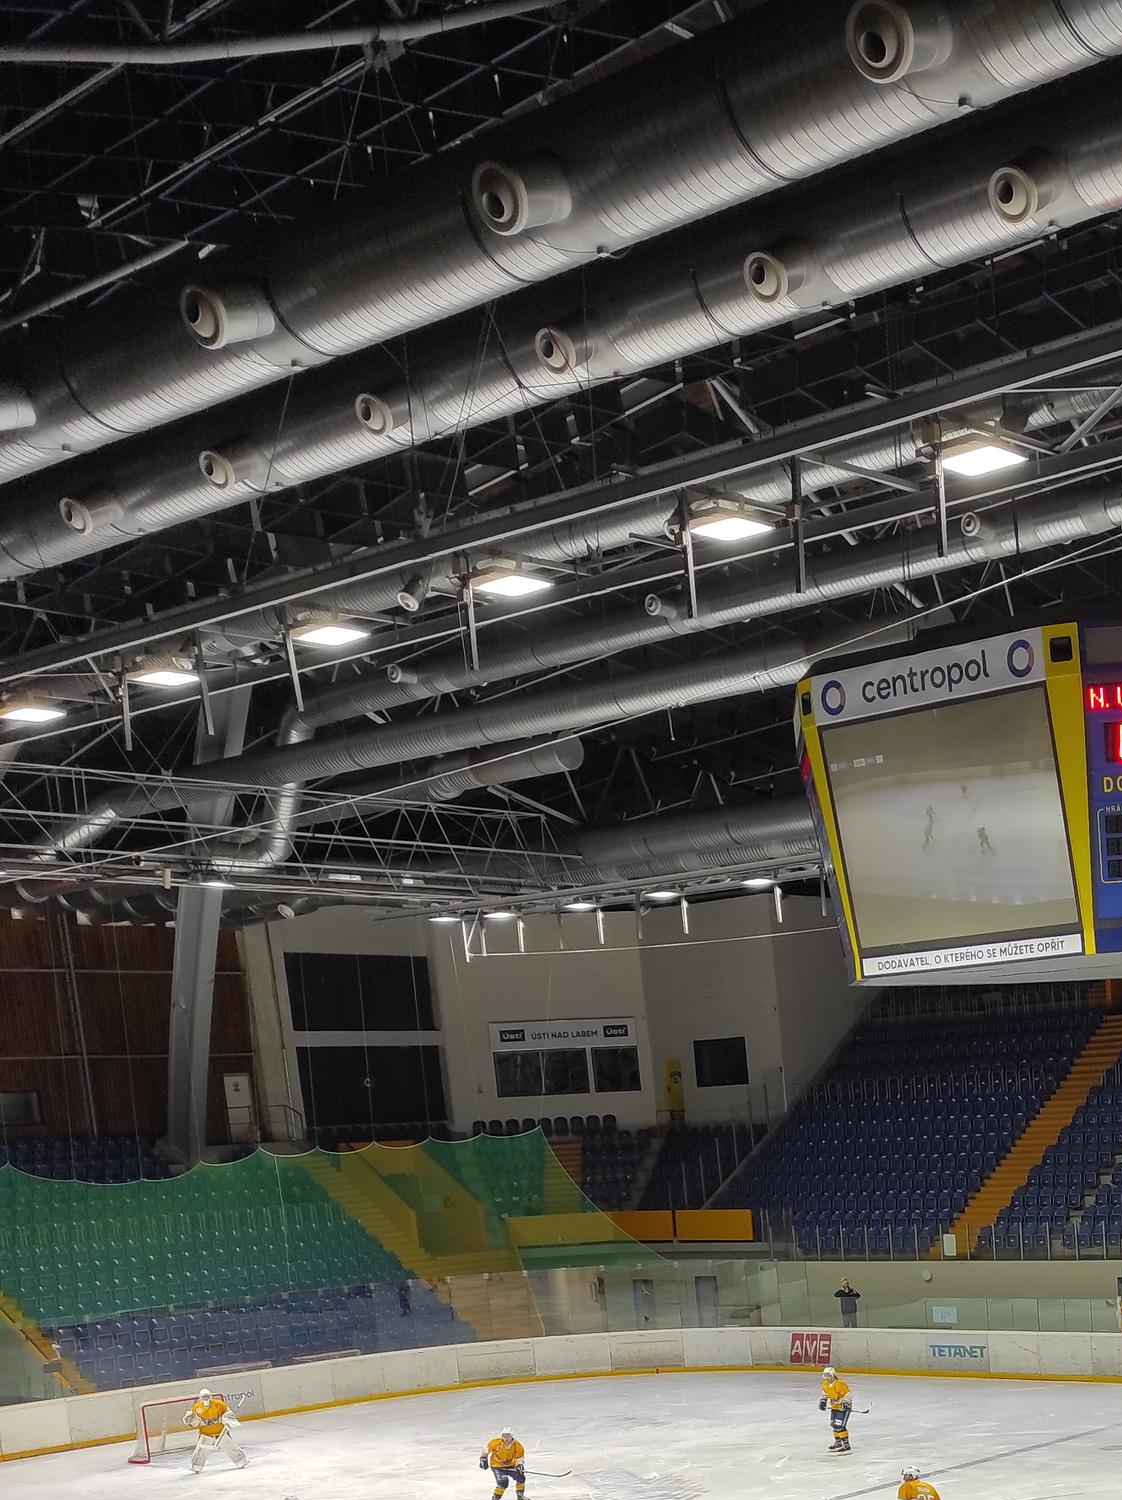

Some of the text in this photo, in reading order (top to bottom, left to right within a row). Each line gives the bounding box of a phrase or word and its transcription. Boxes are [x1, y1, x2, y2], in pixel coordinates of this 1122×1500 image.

[862, 650, 989, 703] centropol
[877, 956, 931, 971] DODAVATEL,
[934, 955, 942, 965] O
[944, 949, 984, 963] KTERÉHO
[987, 948, 997, 958] SE
[1000, 943, 1035, 957] MŮŽETE
[551, 1031, 569, 1039] NAD
[571, 1030, 598, 1039] LABEM
[791, 1337, 831, 1358] AVE
[928, 1344, 987, 1359] TETANET
